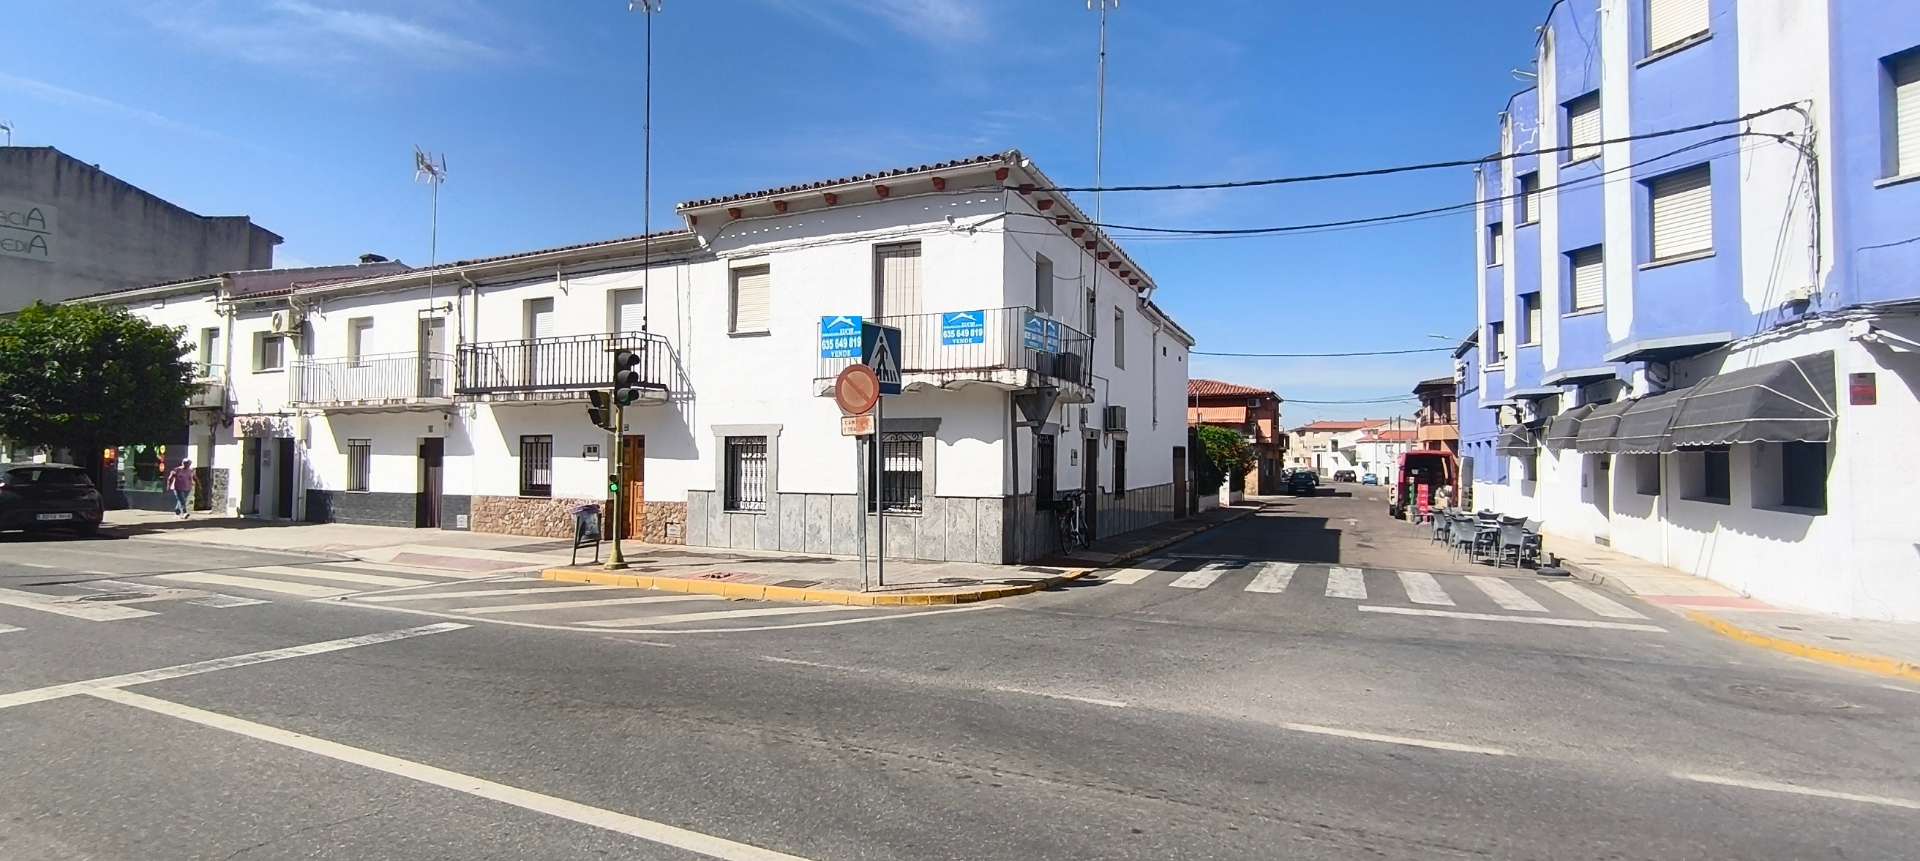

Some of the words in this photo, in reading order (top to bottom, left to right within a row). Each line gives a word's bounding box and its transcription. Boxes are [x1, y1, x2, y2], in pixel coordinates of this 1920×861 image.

[0, 235, 48, 257] EDIA
[944, 330, 955, 338] 635
[957, 329, 969, 338] 649
[822, 338, 834, 349] 635
[835, 337, 847, 349] 649
[849, 336, 861, 347] 819
